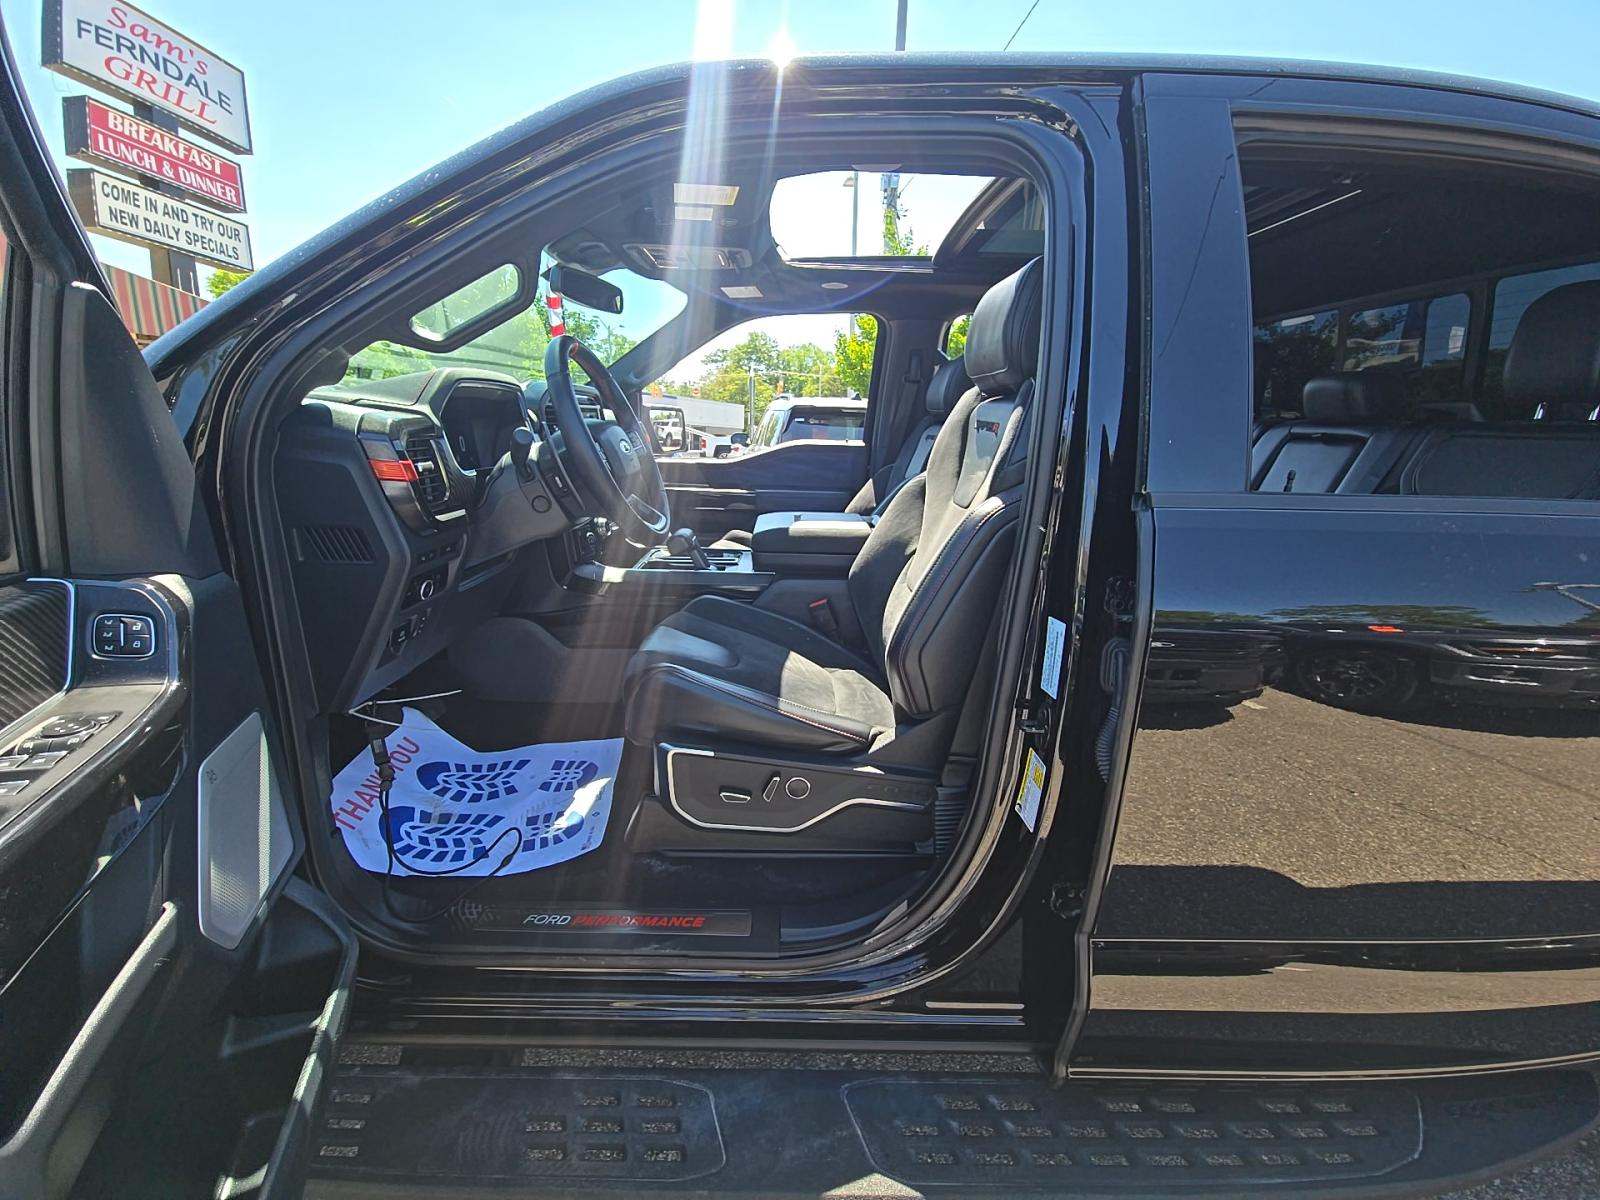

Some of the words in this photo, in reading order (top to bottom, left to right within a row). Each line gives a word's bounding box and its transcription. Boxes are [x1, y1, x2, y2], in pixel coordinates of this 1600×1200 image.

[76, 18, 233, 116] FERNDALE
[107, 6, 208, 76] Sam's
[104, 56, 217, 125] GRILL
[98, 133, 157, 173] LUNCH
[162, 161, 175, 179] &
[179, 169, 237, 204] DINNER
[107, 111, 223, 175] BREAKFAST
[101, 180, 141, 209] COME
[144, 195, 158, 214] IN
[162, 203, 189, 224] AND
[191, 212, 214, 230] TRY
[217, 221, 241, 243] OUR
[108, 205, 139, 230] NEW
[143, 216, 181, 243] DAILY
[184, 230, 240, 261] SPECIALS
[523, 914, 572, 926] FORD
[571, 914, 706, 928] PERFORMANCE
